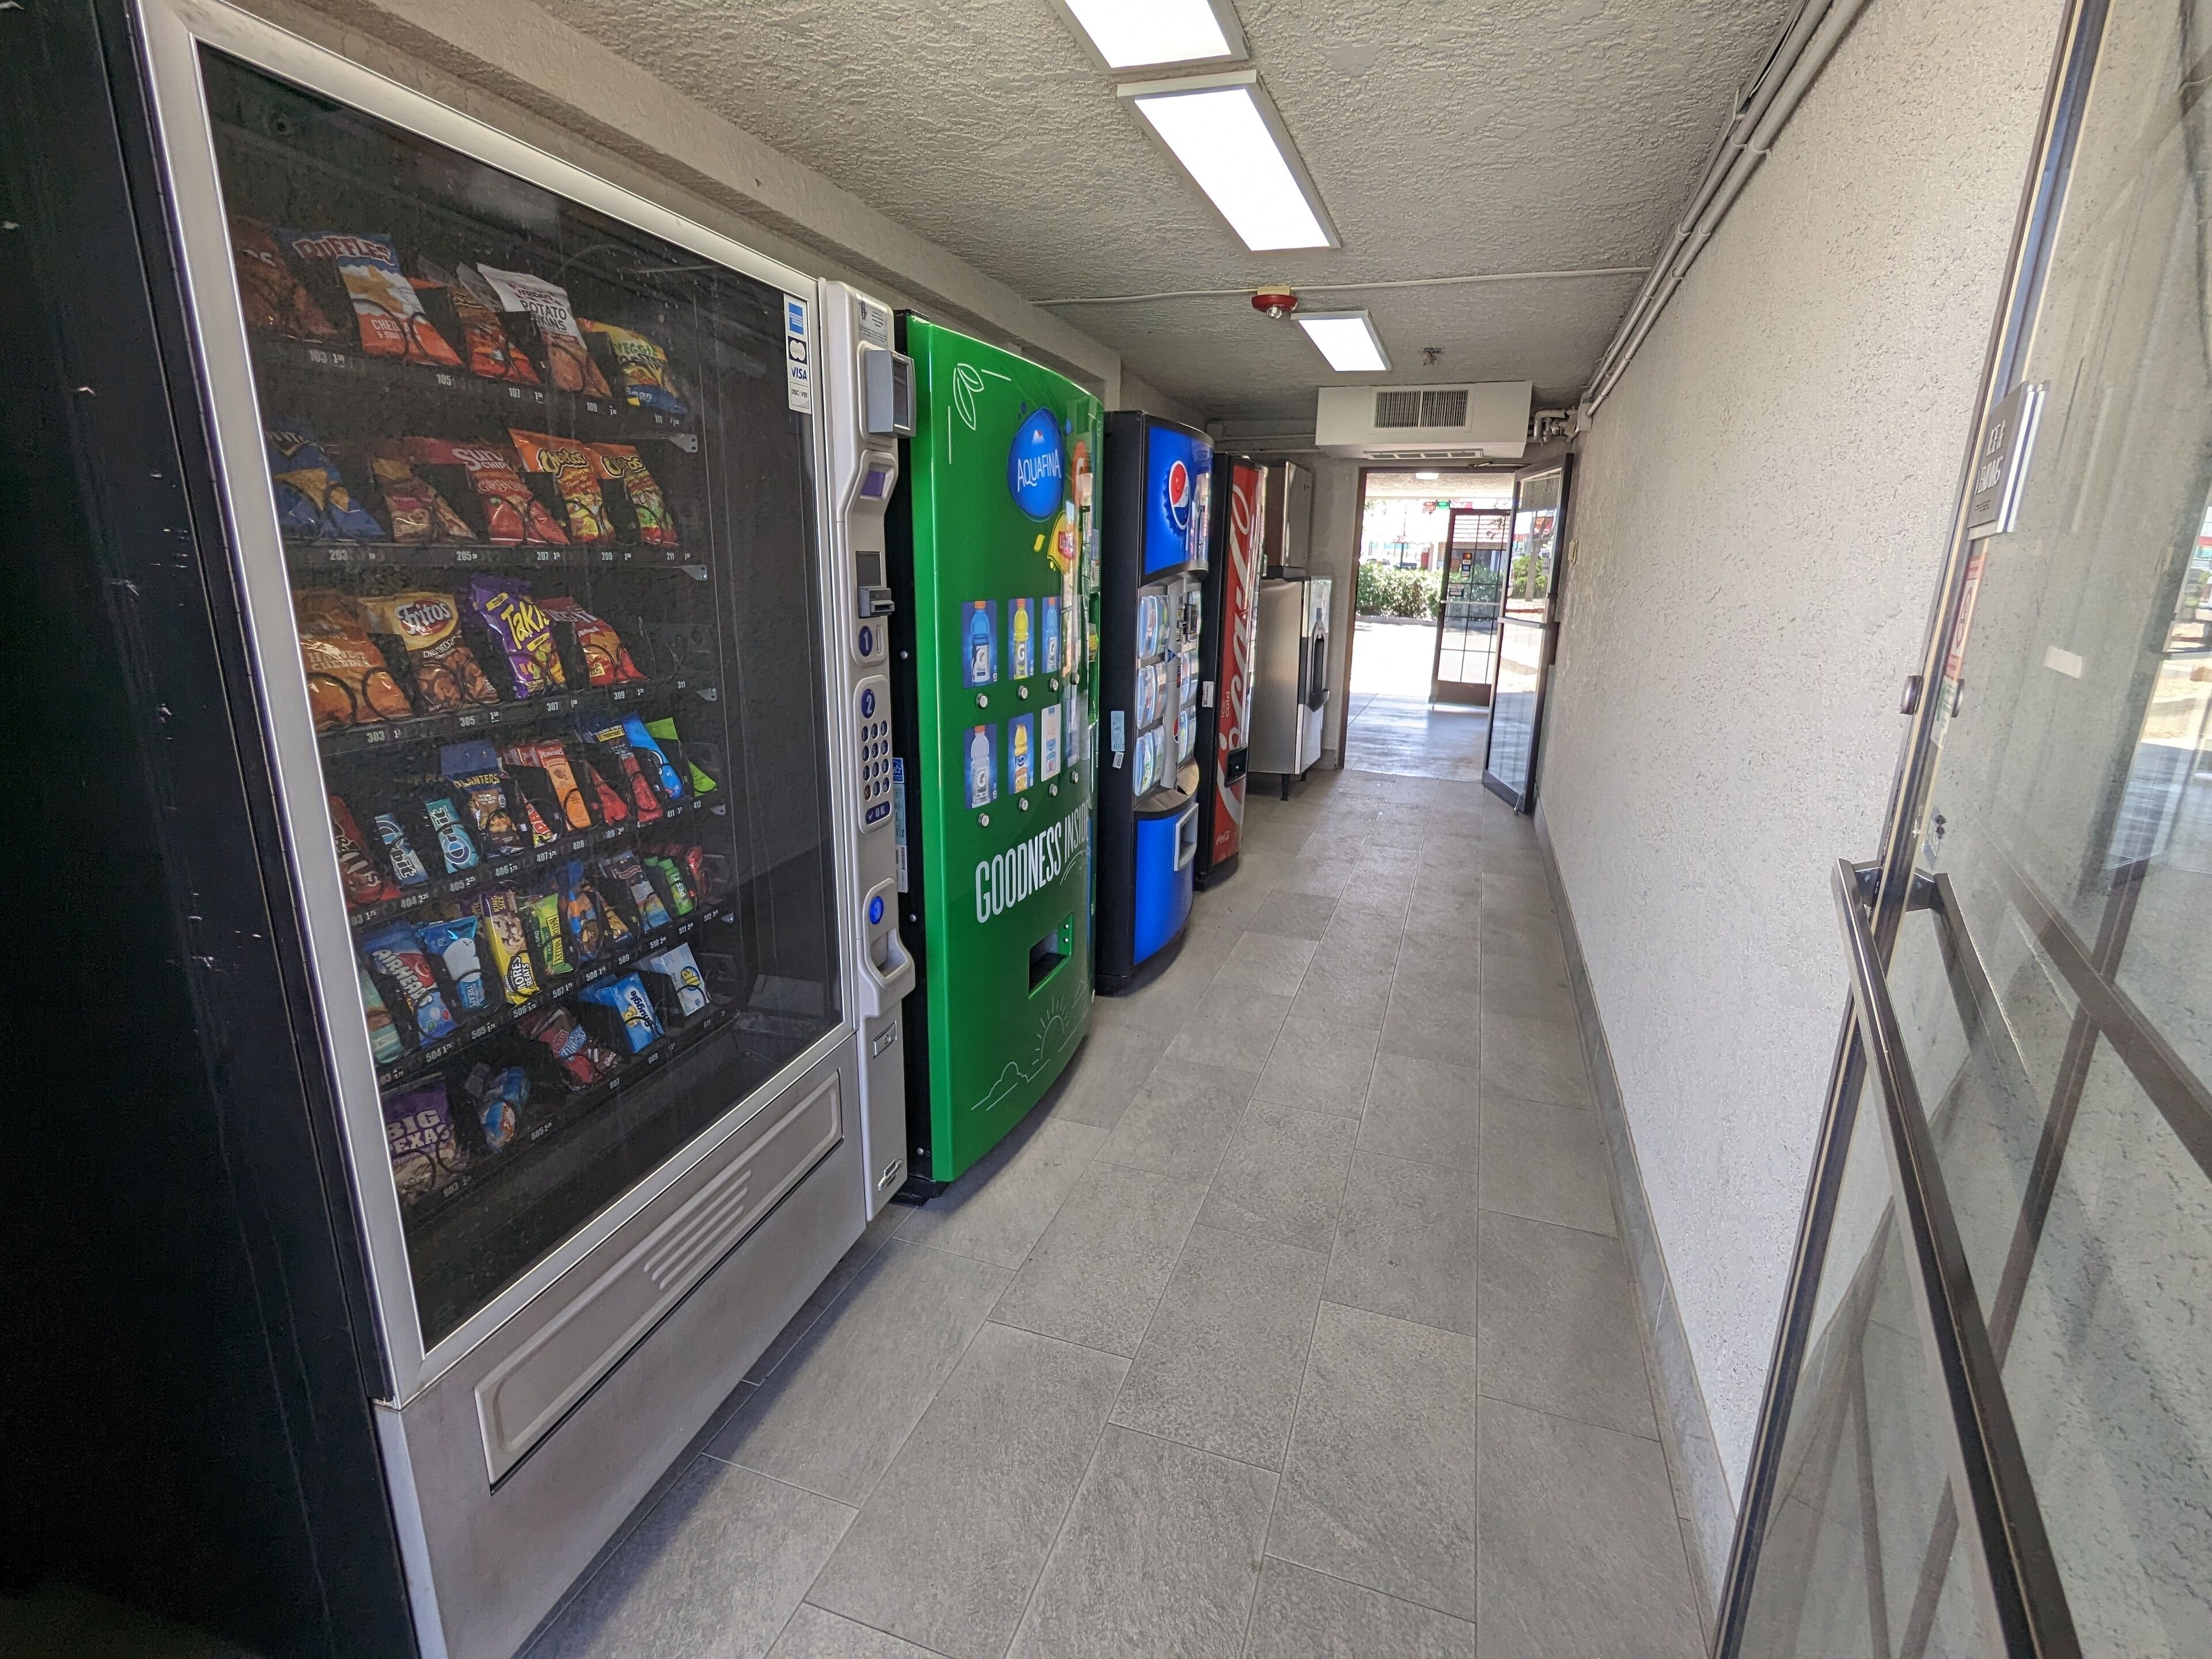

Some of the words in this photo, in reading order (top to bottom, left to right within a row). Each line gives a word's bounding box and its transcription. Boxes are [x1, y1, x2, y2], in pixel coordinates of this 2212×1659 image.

[293, 235, 396, 266] RUFFLES
[520, 300, 567, 321] POTATO
[309, 349, 327, 363] 103
[437, 373, 452, 386] 105
[791, 366, 808, 381] VISA
[508, 387, 521, 398] 107
[791, 388, 808, 399] DISCVER
[586, 402, 598, 412] 109
[654, 414, 663, 424] 111
[1017, 448, 1062, 493] AQUAFINA
[329, 549, 349, 560] 203
[456, 551, 472, 561] 205
[537, 551, 549, 561] 207
[601, 552, 613, 560] 209
[666, 551, 675, 560] 211
[395, 602, 452, 635] Fritos
[677, 680, 686, 690] 311
[613, 691, 625, 700] 309
[546, 702, 559, 712] 307
[866, 694, 873, 715] 2
[459, 717, 475, 728] 305
[366, 730, 385, 744] 303
[453, 773, 501, 789] PLANTERS
[692, 800, 702, 809] 412
[874, 805, 886, 818] OK
[375, 818, 416, 878] Obit
[573, 840, 585, 850] 408
[536, 853, 548, 863] 407
[495, 865, 509, 877] 406
[975, 821, 1062, 923] GOODNESS
[449, 879, 465, 892] 405
[400, 896, 418, 908] 404
[491, 895, 501, 913] KING
[703, 912, 712, 922] 512
[549, 916, 561, 940] NATU
[679, 926, 687, 935] 511
[650, 939, 660, 949] 510
[553, 939, 565, 964] VALLEY
[618, 953, 630, 965] 509
[372, 948, 434, 1009] AIRHEADS
[585, 970, 598, 982] 508
[552, 986, 564, 999] 507
[513, 1006, 527, 1018] 506
[631, 990, 654, 1028] Snuggle
[471, 1028, 486, 1040] 505
[425, 1050, 442, 1063] 504
[647, 1052, 658, 1064] 609
[609, 1077, 620, 1089] 607
[388, 1109, 441, 1143] BIG
[392, 1124, 451, 1153] EXAS
[531, 1128, 544, 1141] 605
